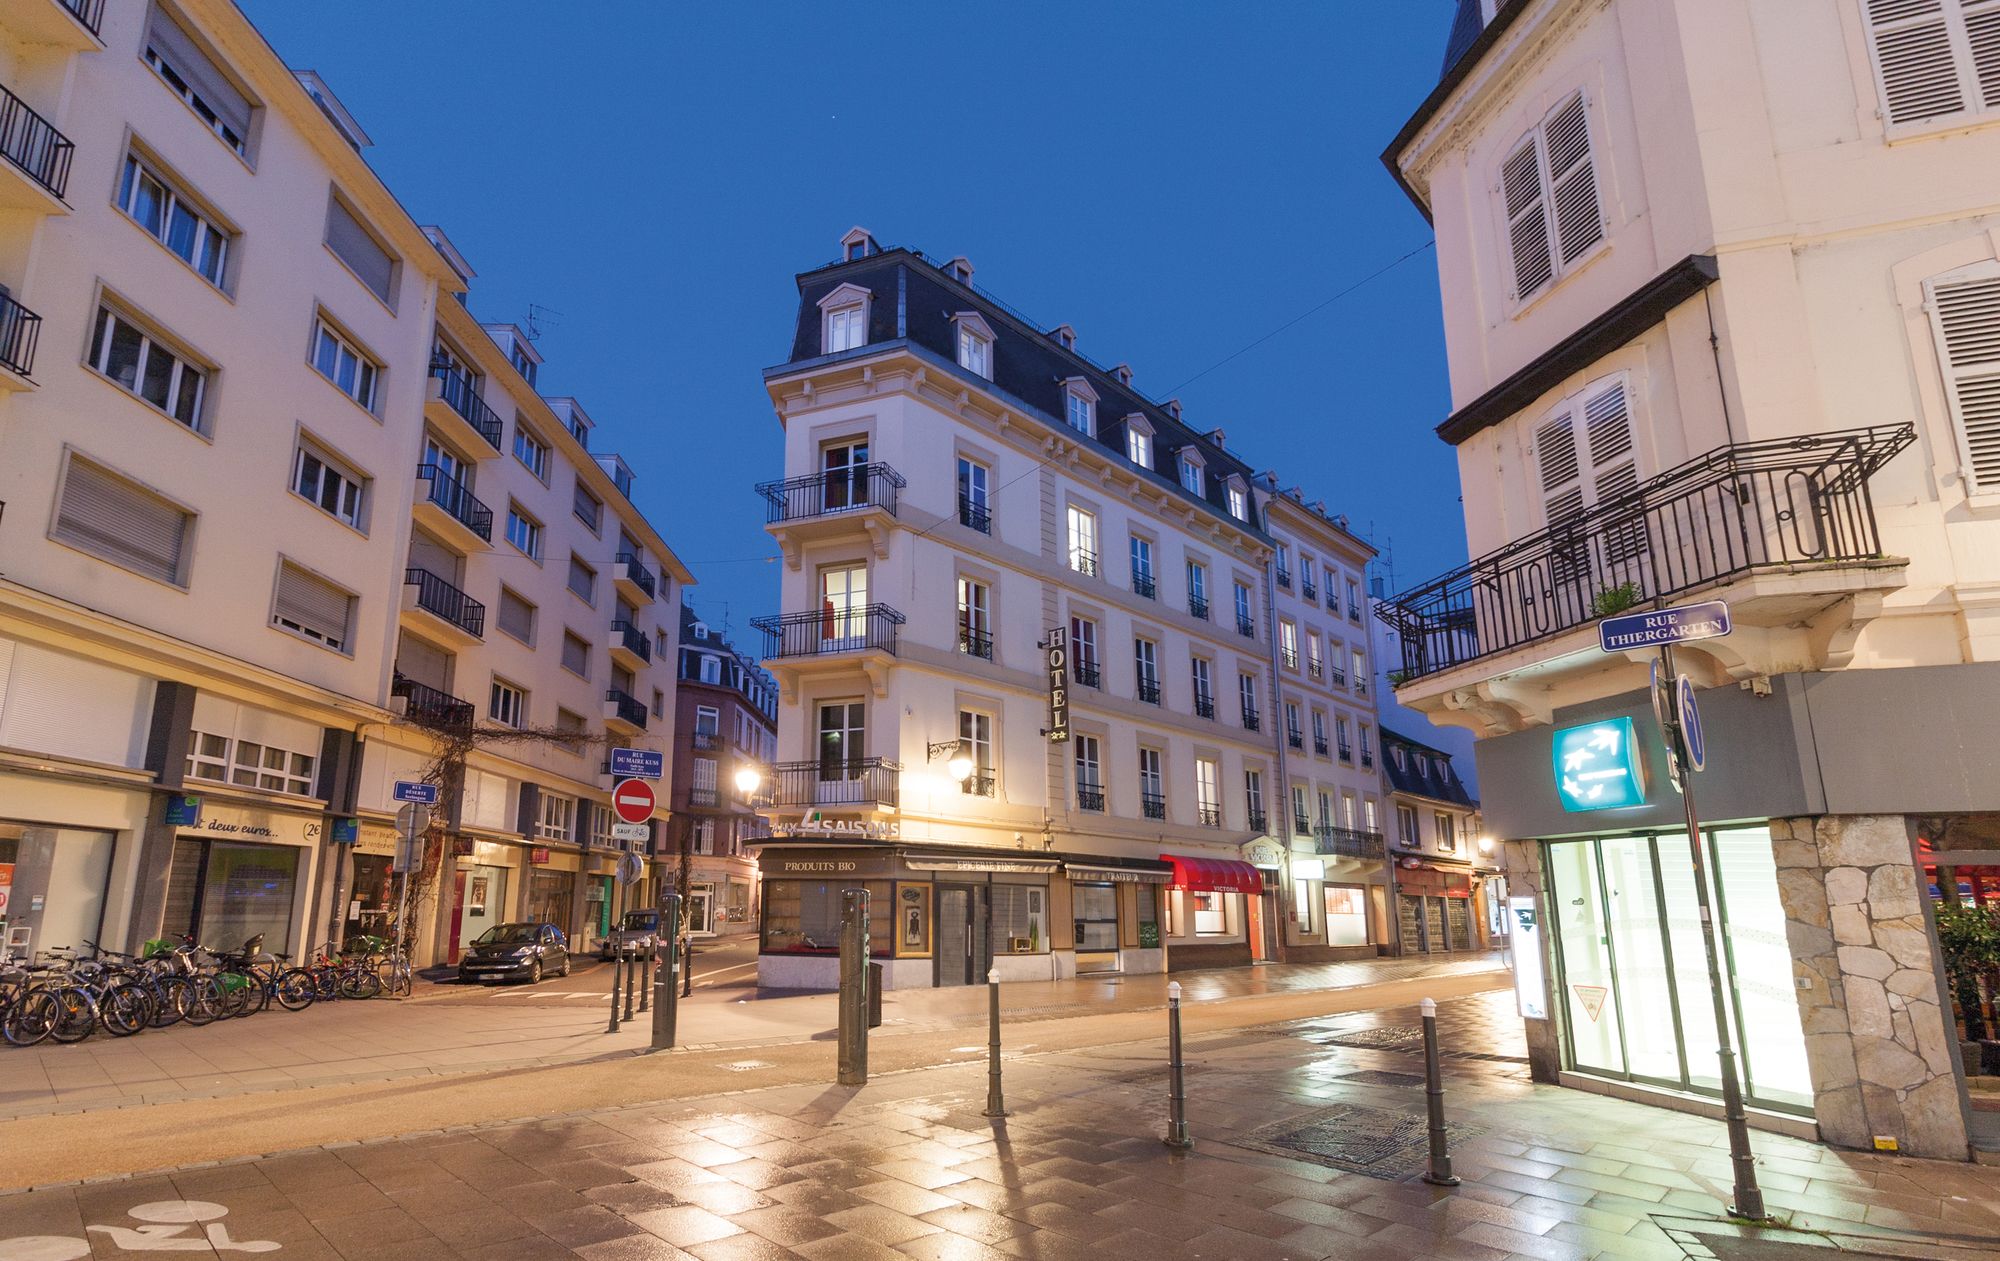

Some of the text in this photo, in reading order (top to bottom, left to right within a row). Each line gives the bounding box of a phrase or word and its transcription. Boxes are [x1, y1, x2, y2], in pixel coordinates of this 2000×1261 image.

[1645, 613, 1678, 628] RUE
[1607, 619, 1722, 646] THIERGARTEN
[1049, 629, 1066, 728] HOTEL
[626, 757, 645, 765] MAIRE
[208, 819, 240, 834] deux
[770, 807, 899, 836] AUX 4 SAISONS
[785, 862, 856, 871] PRODUITS BIO
